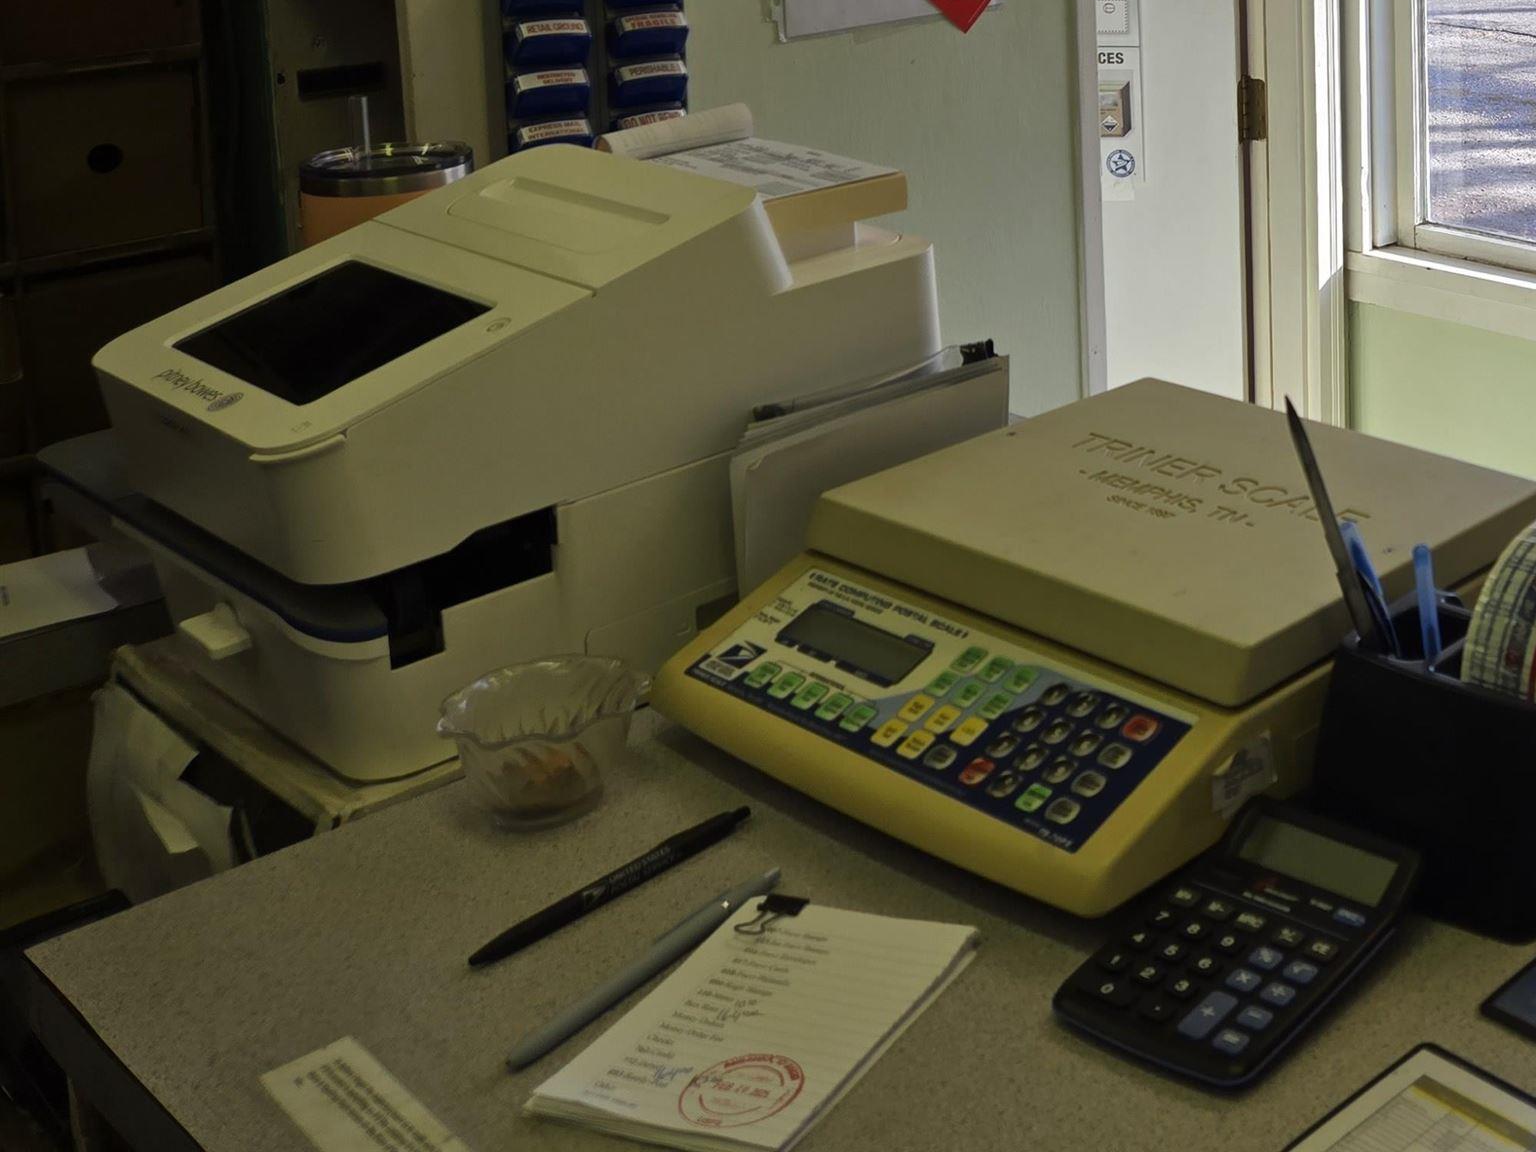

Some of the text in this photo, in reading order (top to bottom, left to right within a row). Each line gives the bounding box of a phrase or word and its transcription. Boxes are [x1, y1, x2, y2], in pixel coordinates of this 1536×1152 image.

[1098, 52, 1124, 64] CES
[152, 369, 223, 401] pitney bowes
[1072, 432, 1222, 482] TRINER
[1100, 982, 1115, 994] 0
